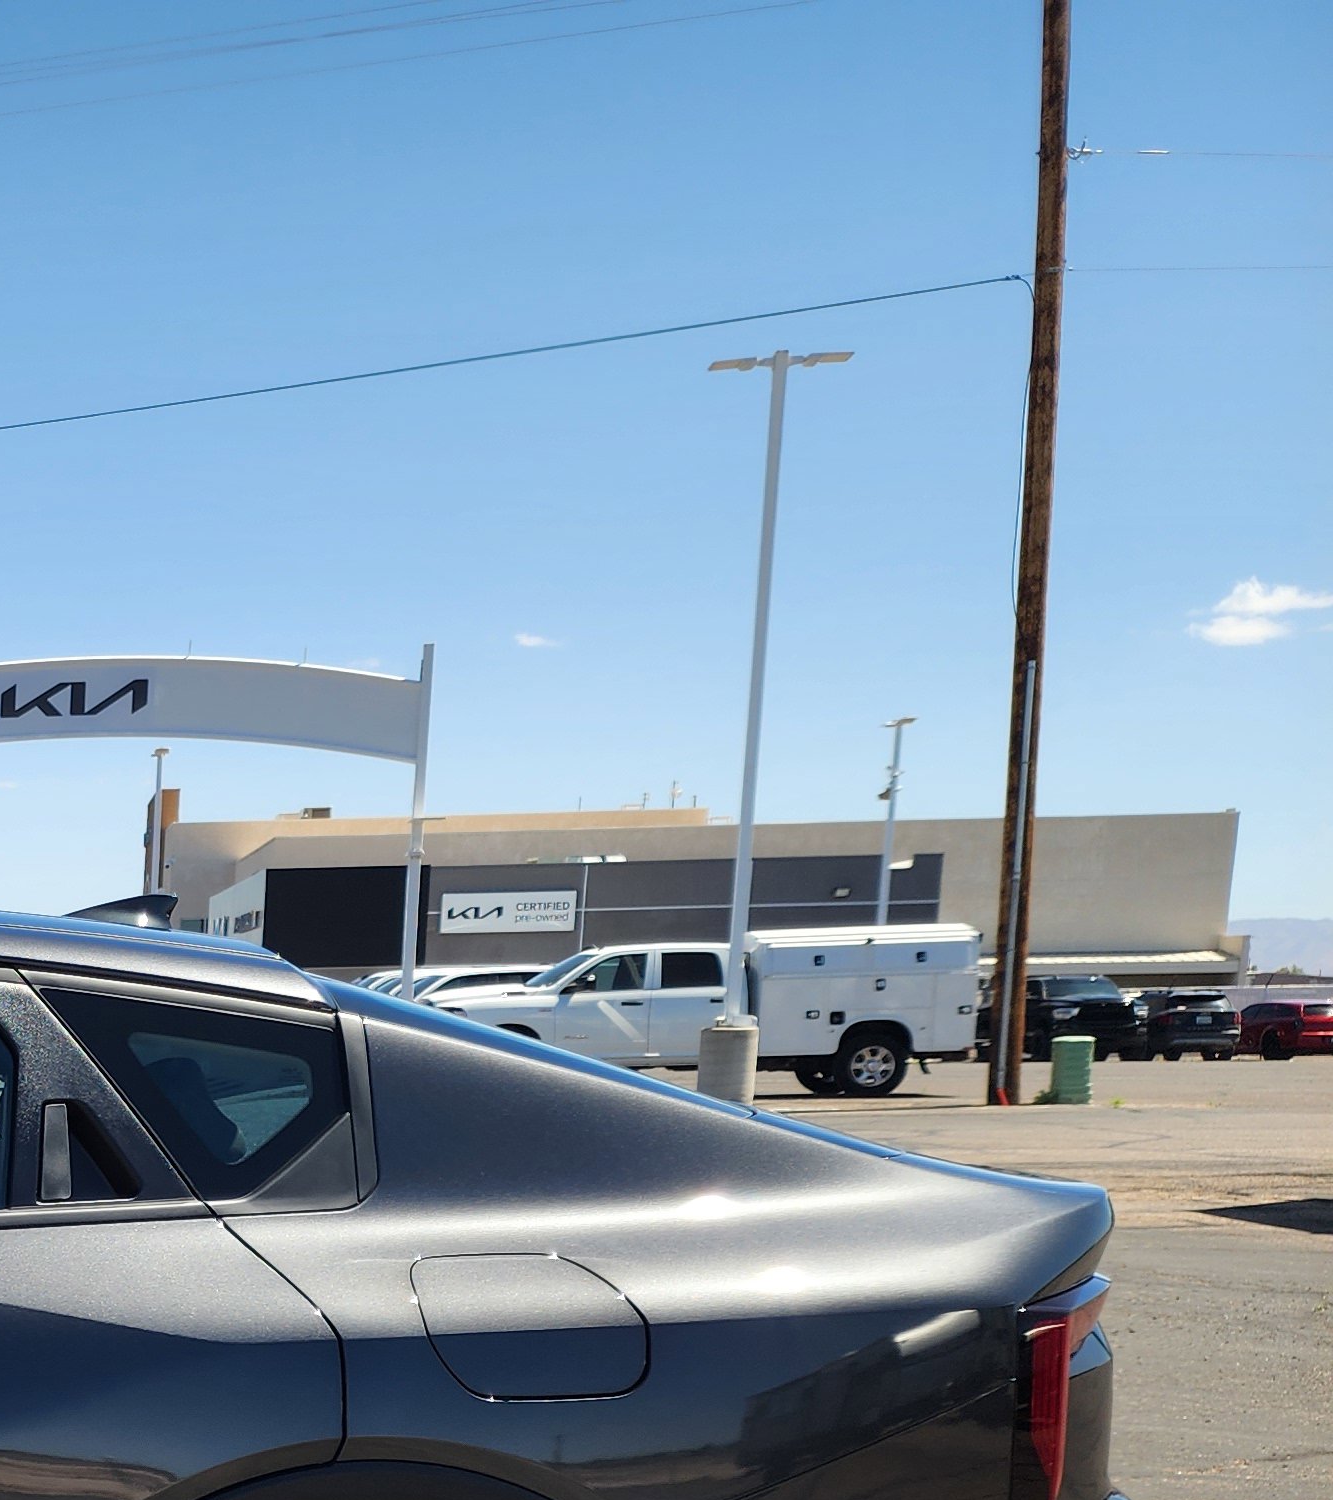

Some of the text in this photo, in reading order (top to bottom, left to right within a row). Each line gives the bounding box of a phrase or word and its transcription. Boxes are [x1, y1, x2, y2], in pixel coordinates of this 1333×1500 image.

[0, 678, 149, 718] KIA
[447, 906, 504, 920] KIA
[515, 902, 571, 912] CERTIFIED
[514, 913, 570, 923] pre-owned
